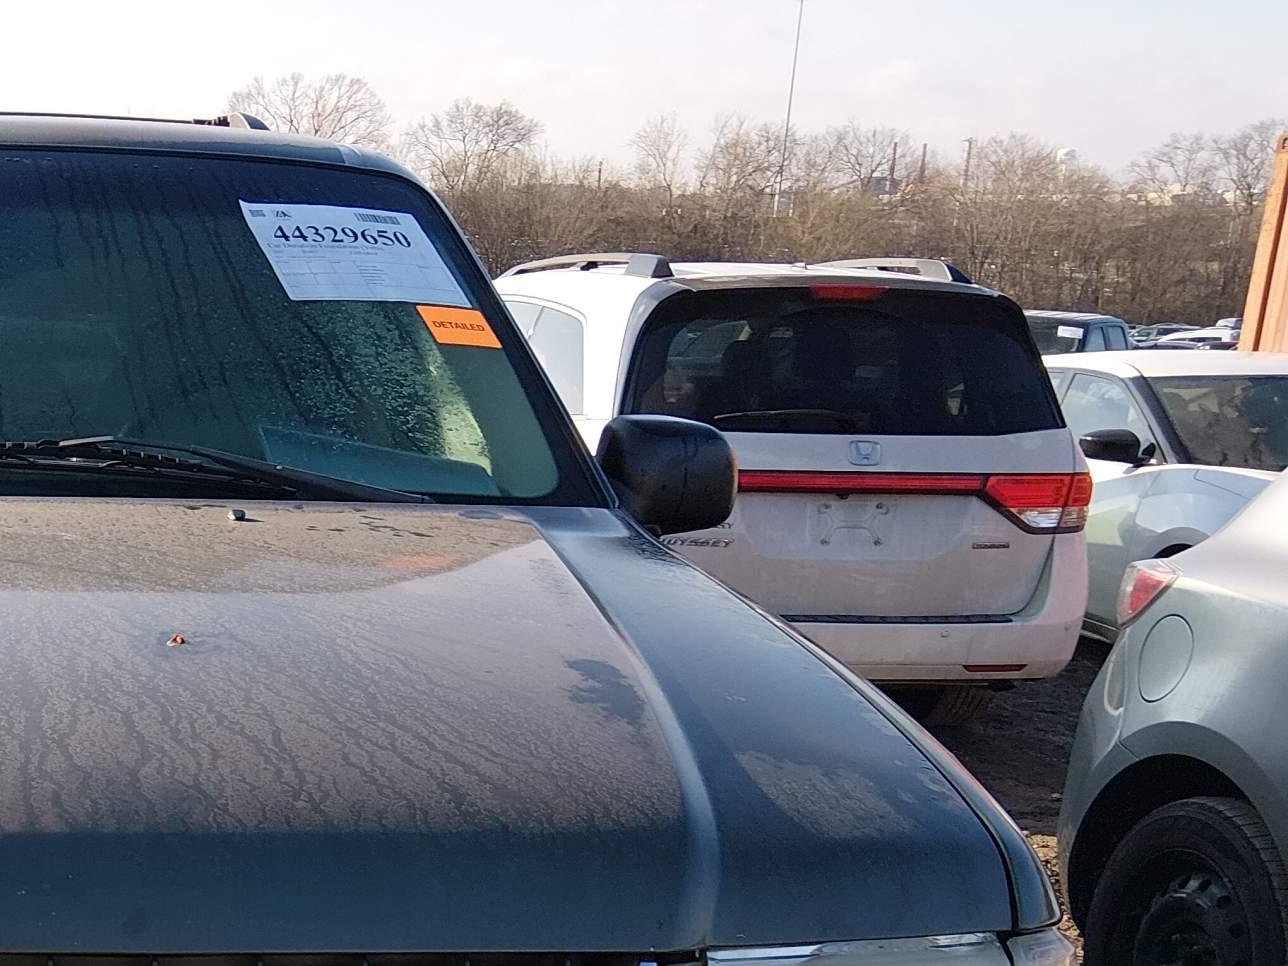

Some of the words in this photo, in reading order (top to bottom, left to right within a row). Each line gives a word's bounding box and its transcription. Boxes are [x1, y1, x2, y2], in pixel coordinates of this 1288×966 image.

[274, 225, 412, 248] 44329650
[432, 320, 486, 332] DETAILED
[660, 536, 734, 548] DYSSEY
